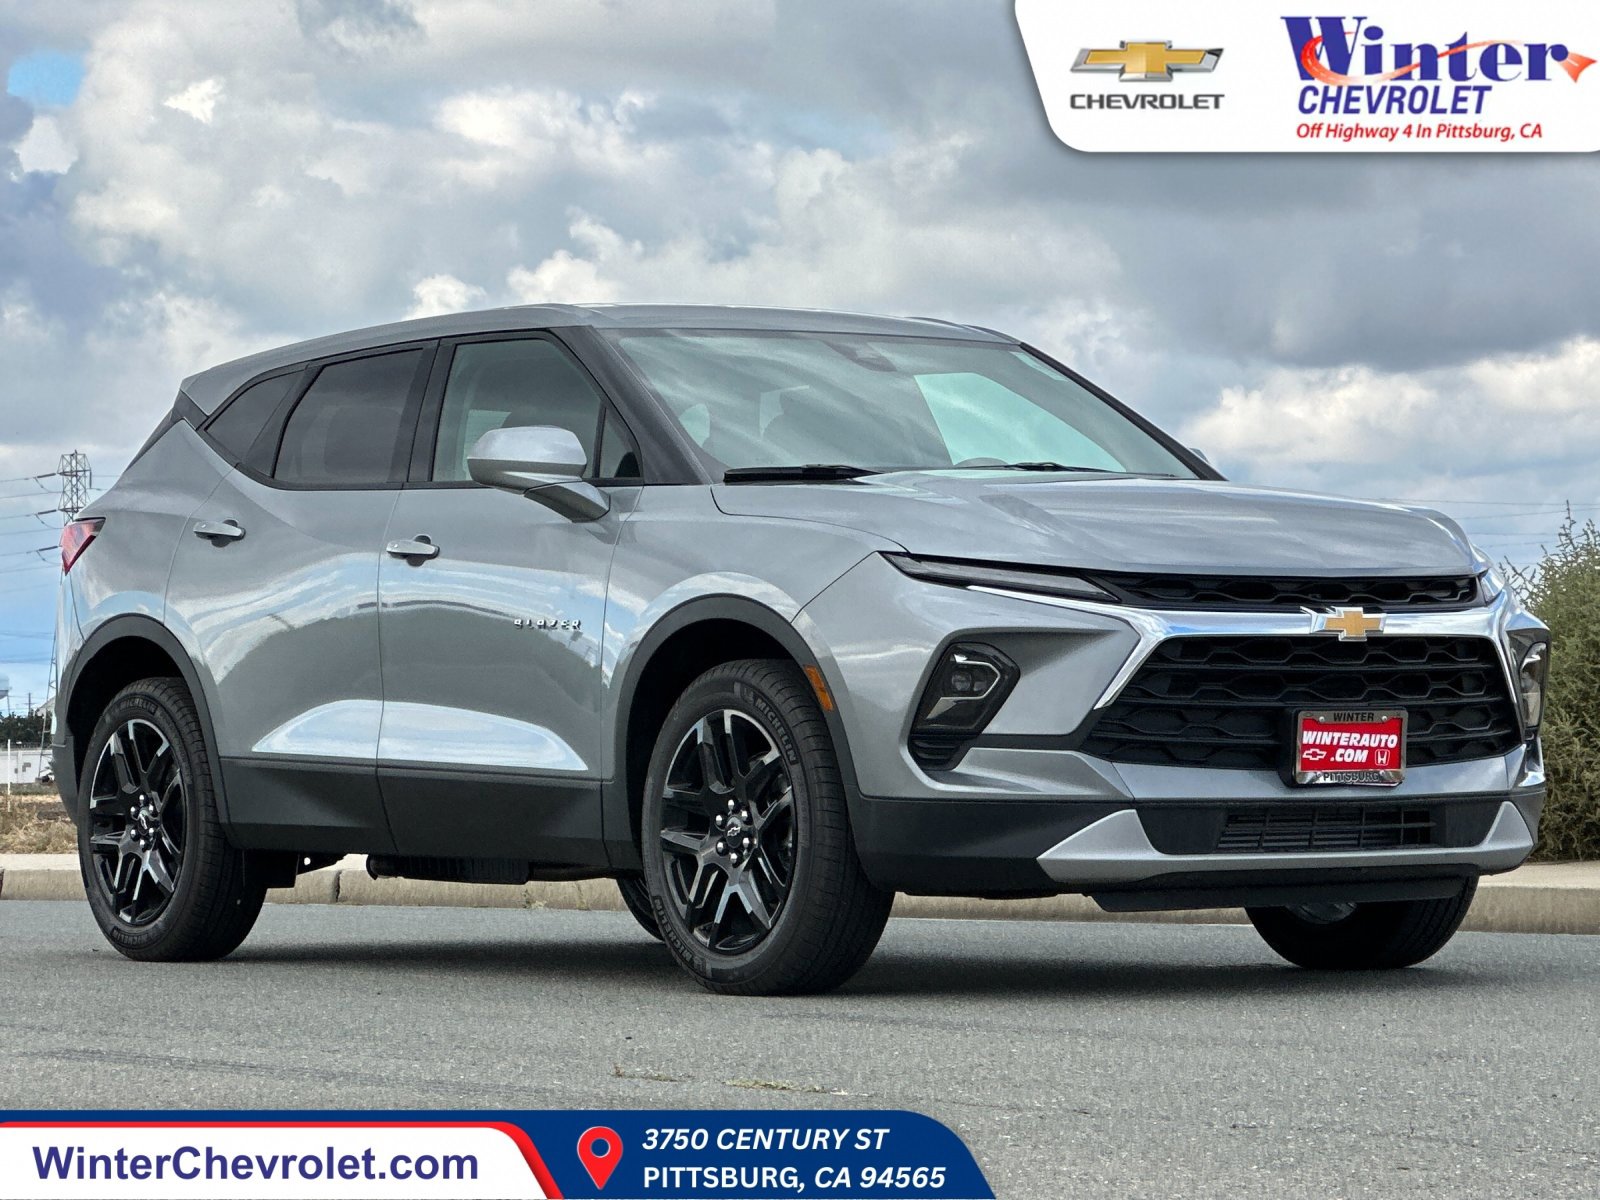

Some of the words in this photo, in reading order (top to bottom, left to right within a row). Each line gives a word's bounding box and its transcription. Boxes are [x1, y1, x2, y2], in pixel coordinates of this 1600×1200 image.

[1333, 712, 1374, 722] WINTER
[755, 697, 797, 761] MICHELIN
[1302, 731, 1398, 749] WINTERAUTO
[1330, 748, 1369, 762] .COM
[1323, 771, 1379, 783] PITTSBURG
